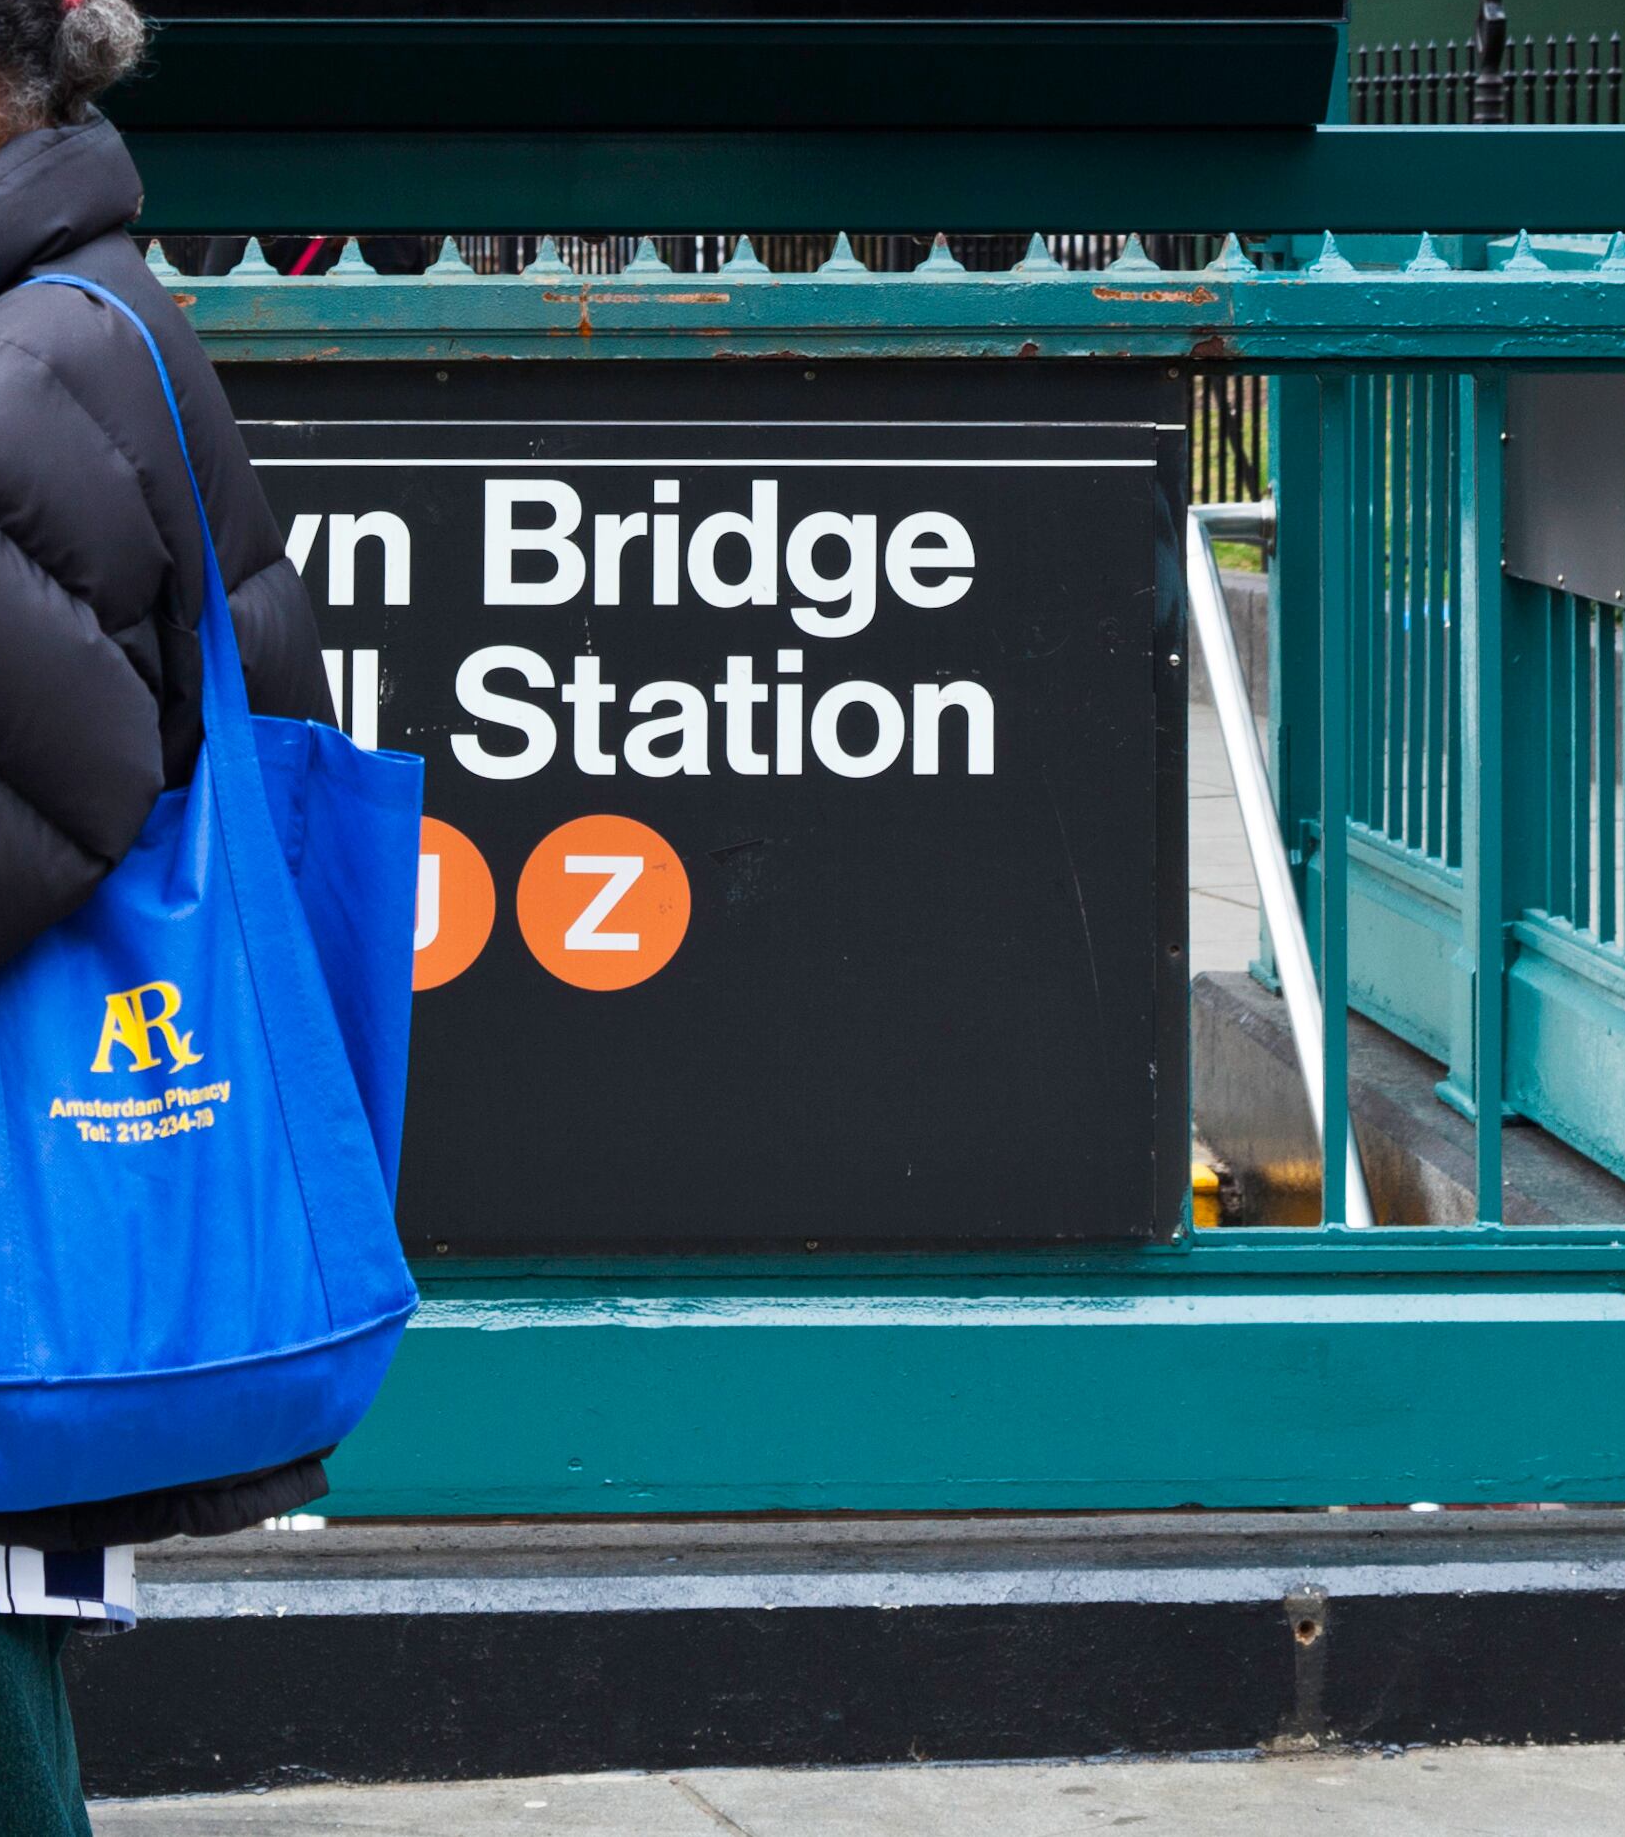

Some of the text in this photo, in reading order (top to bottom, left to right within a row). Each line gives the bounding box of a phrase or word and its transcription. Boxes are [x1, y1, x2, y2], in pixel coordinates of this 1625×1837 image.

[483, 479, 977, 639] Bridge
[450, 645, 996, 780] Station
[564, 855, 645, 952] Z
[49, 1097, 163, 1118] Amsterdam
